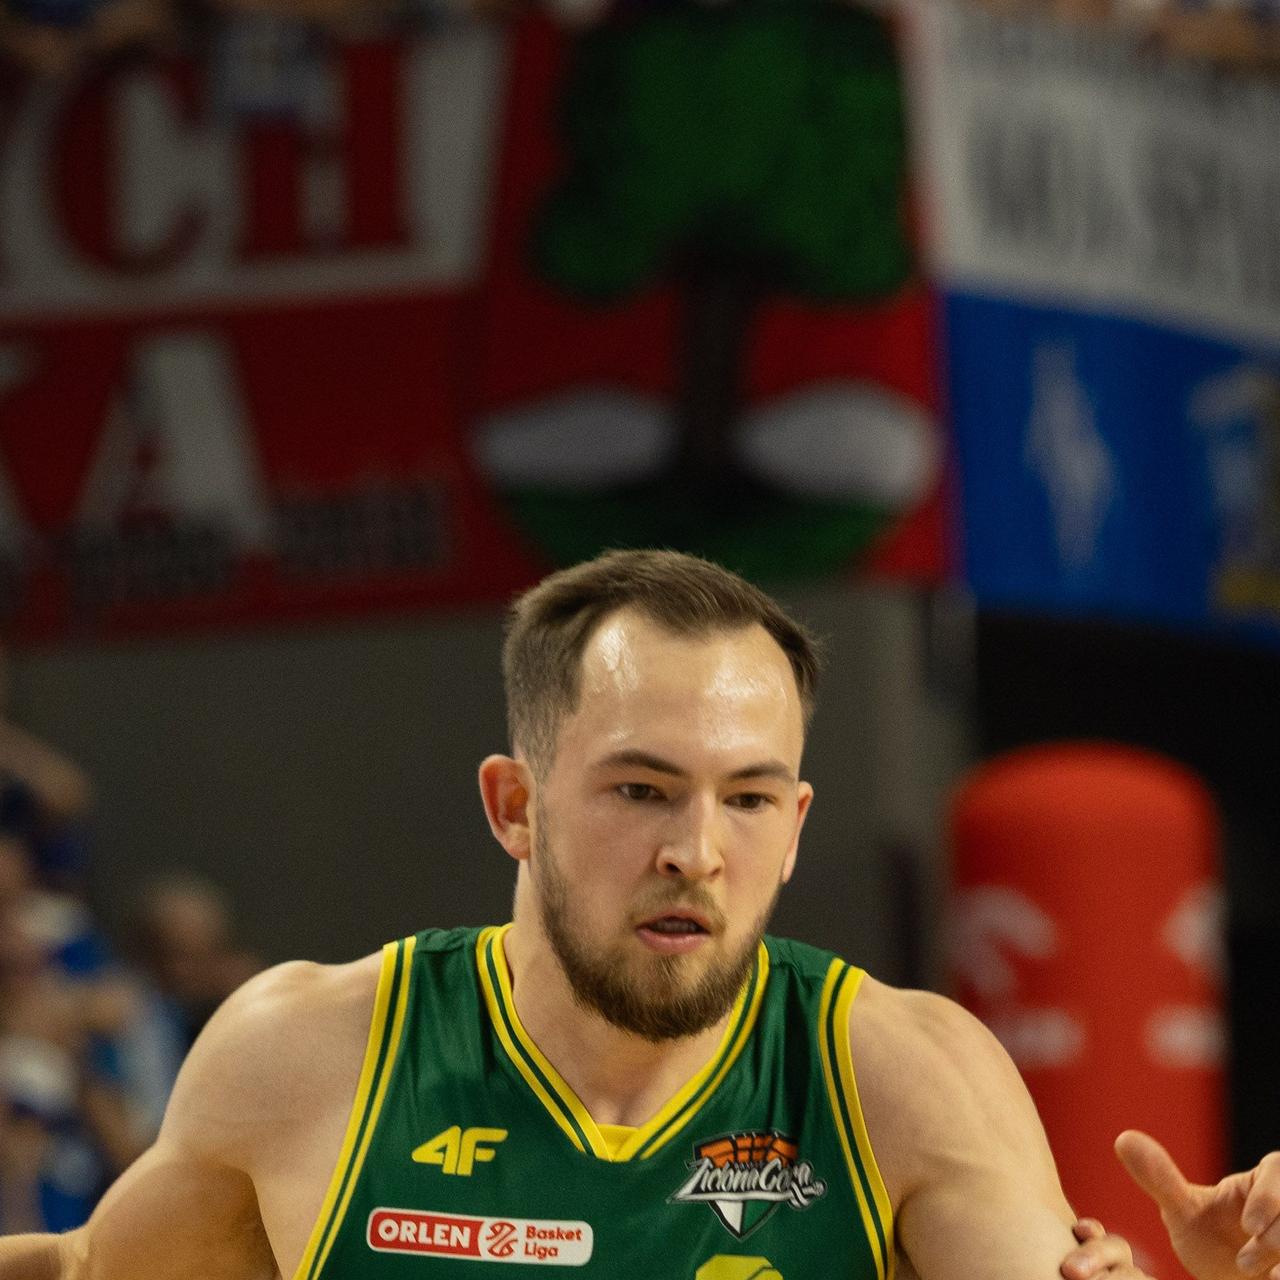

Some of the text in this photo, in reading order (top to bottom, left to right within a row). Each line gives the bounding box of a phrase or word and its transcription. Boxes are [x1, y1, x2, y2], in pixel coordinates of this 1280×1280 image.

[412, 1125, 509, 1177] 4F
[378, 1219, 471, 1249] ORLEN
[526, 1225, 583, 1242] Basket
[524, 1242, 559, 1260] Liga
